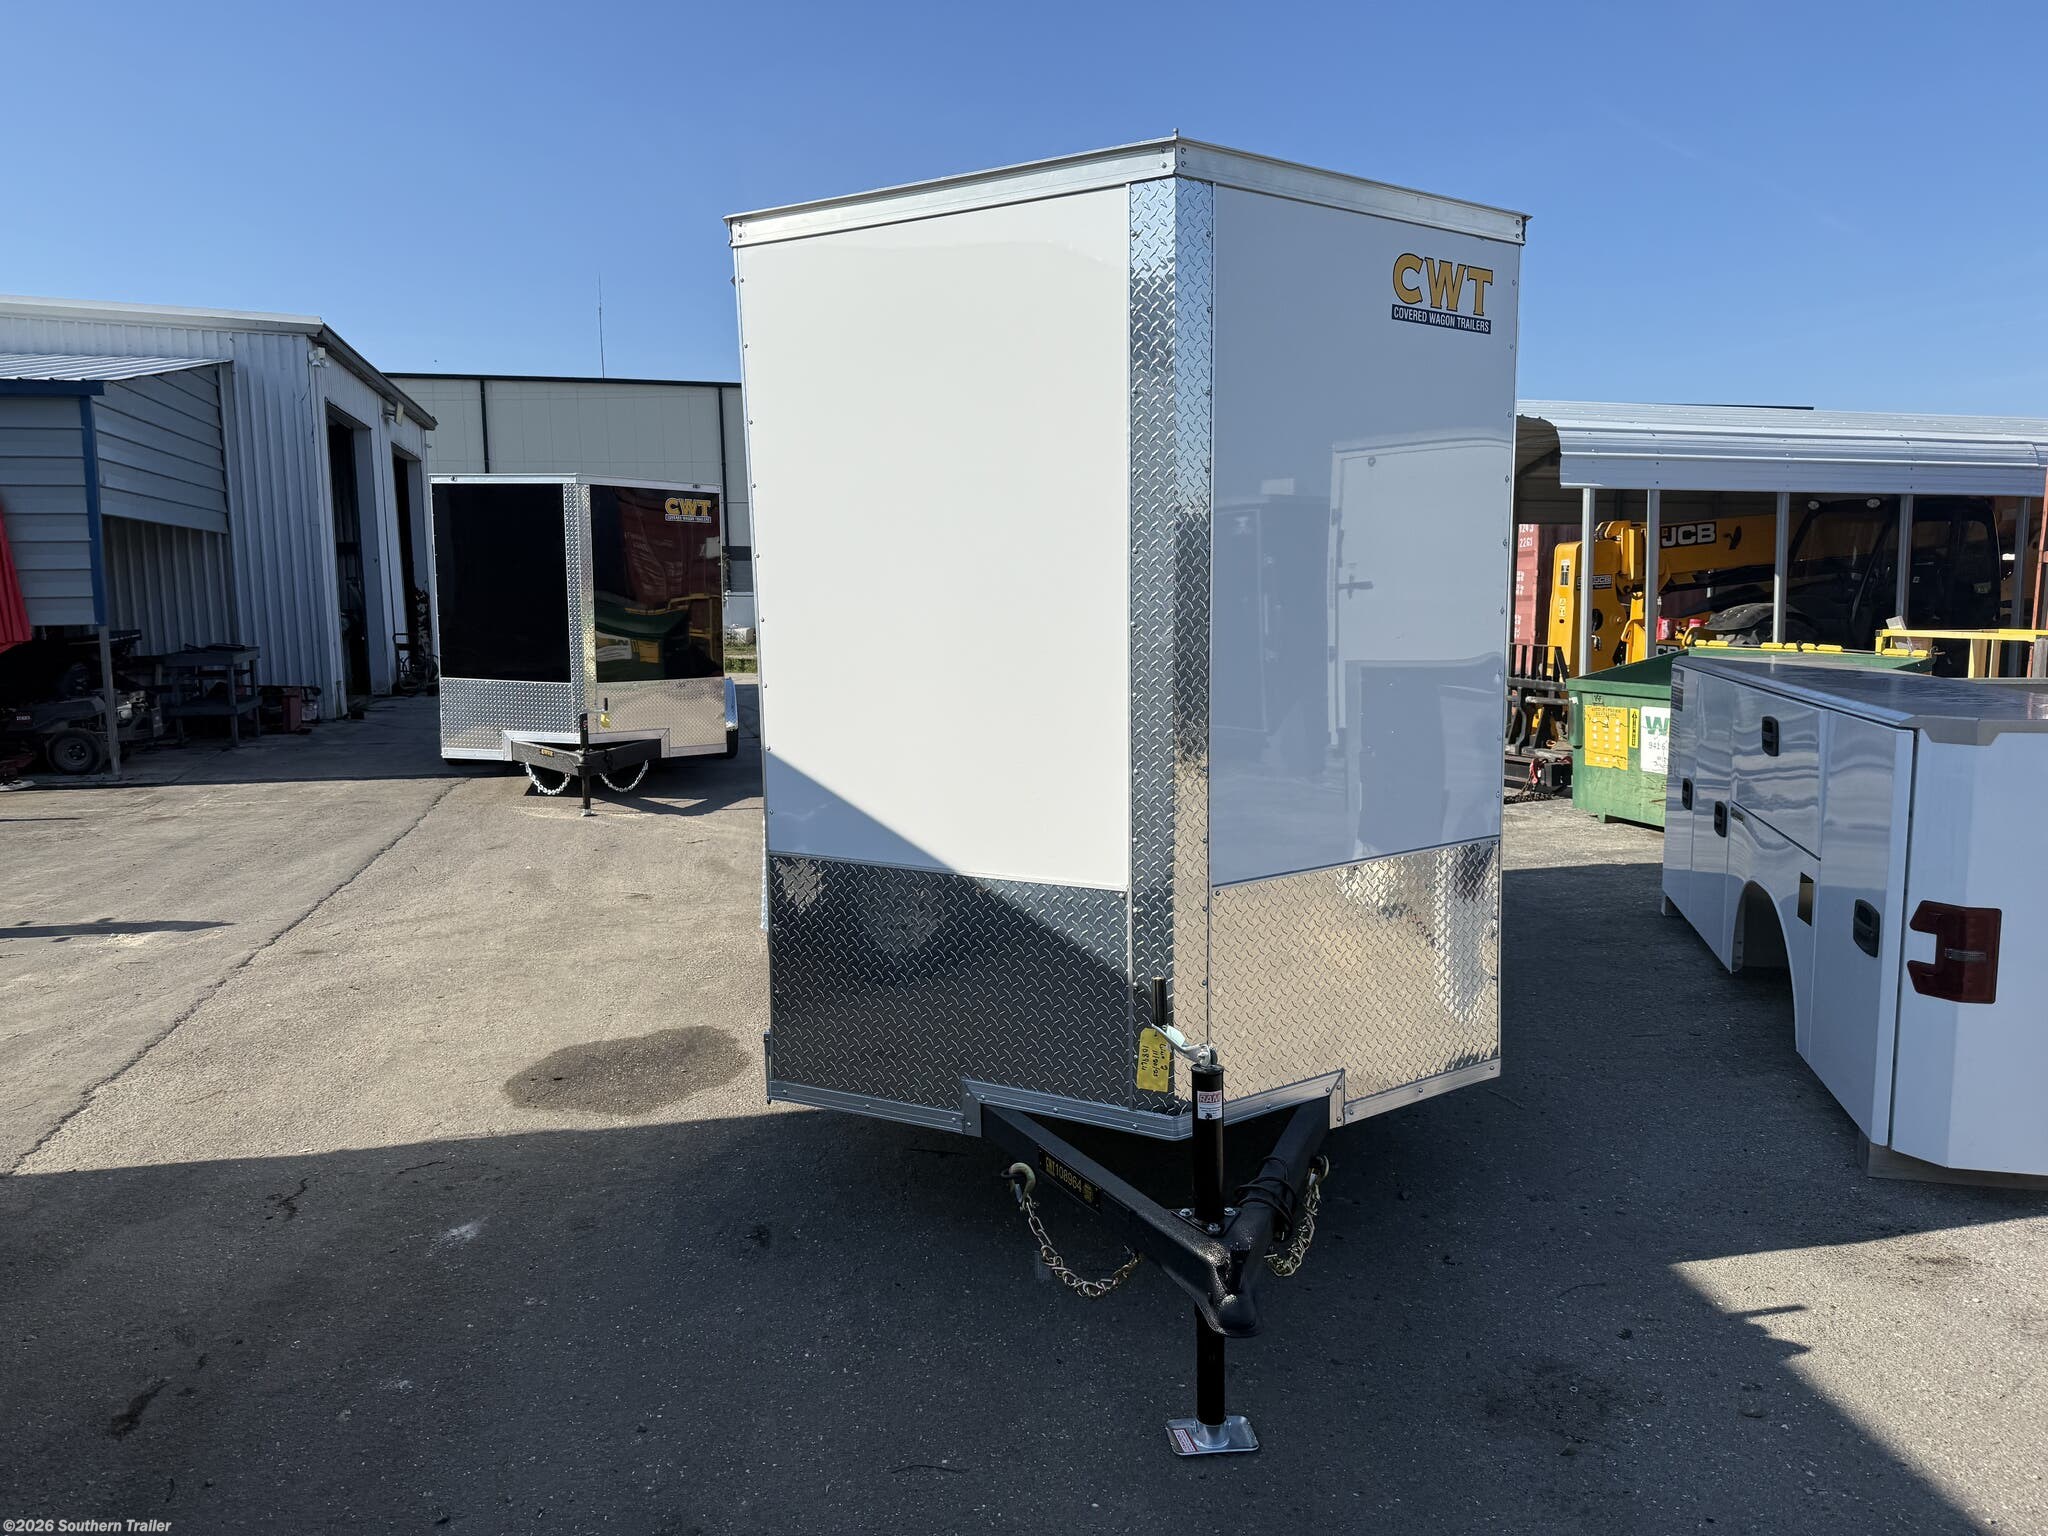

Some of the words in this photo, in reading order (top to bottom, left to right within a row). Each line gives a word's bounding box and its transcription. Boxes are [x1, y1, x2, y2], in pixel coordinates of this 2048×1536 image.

[1393, 253, 1493, 316] CWT
[1393, 306, 1427, 323] COVERED
[1429, 312, 1455, 327] WAGON
[1456, 317, 1490, 332] TRAILERS
[665, 498, 711, 517] CWT
[1661, 523, 1716, 547] JCB
[1199, 1094, 1221, 1104] RAM
[1055, 1163, 1083, 1193] 108964
